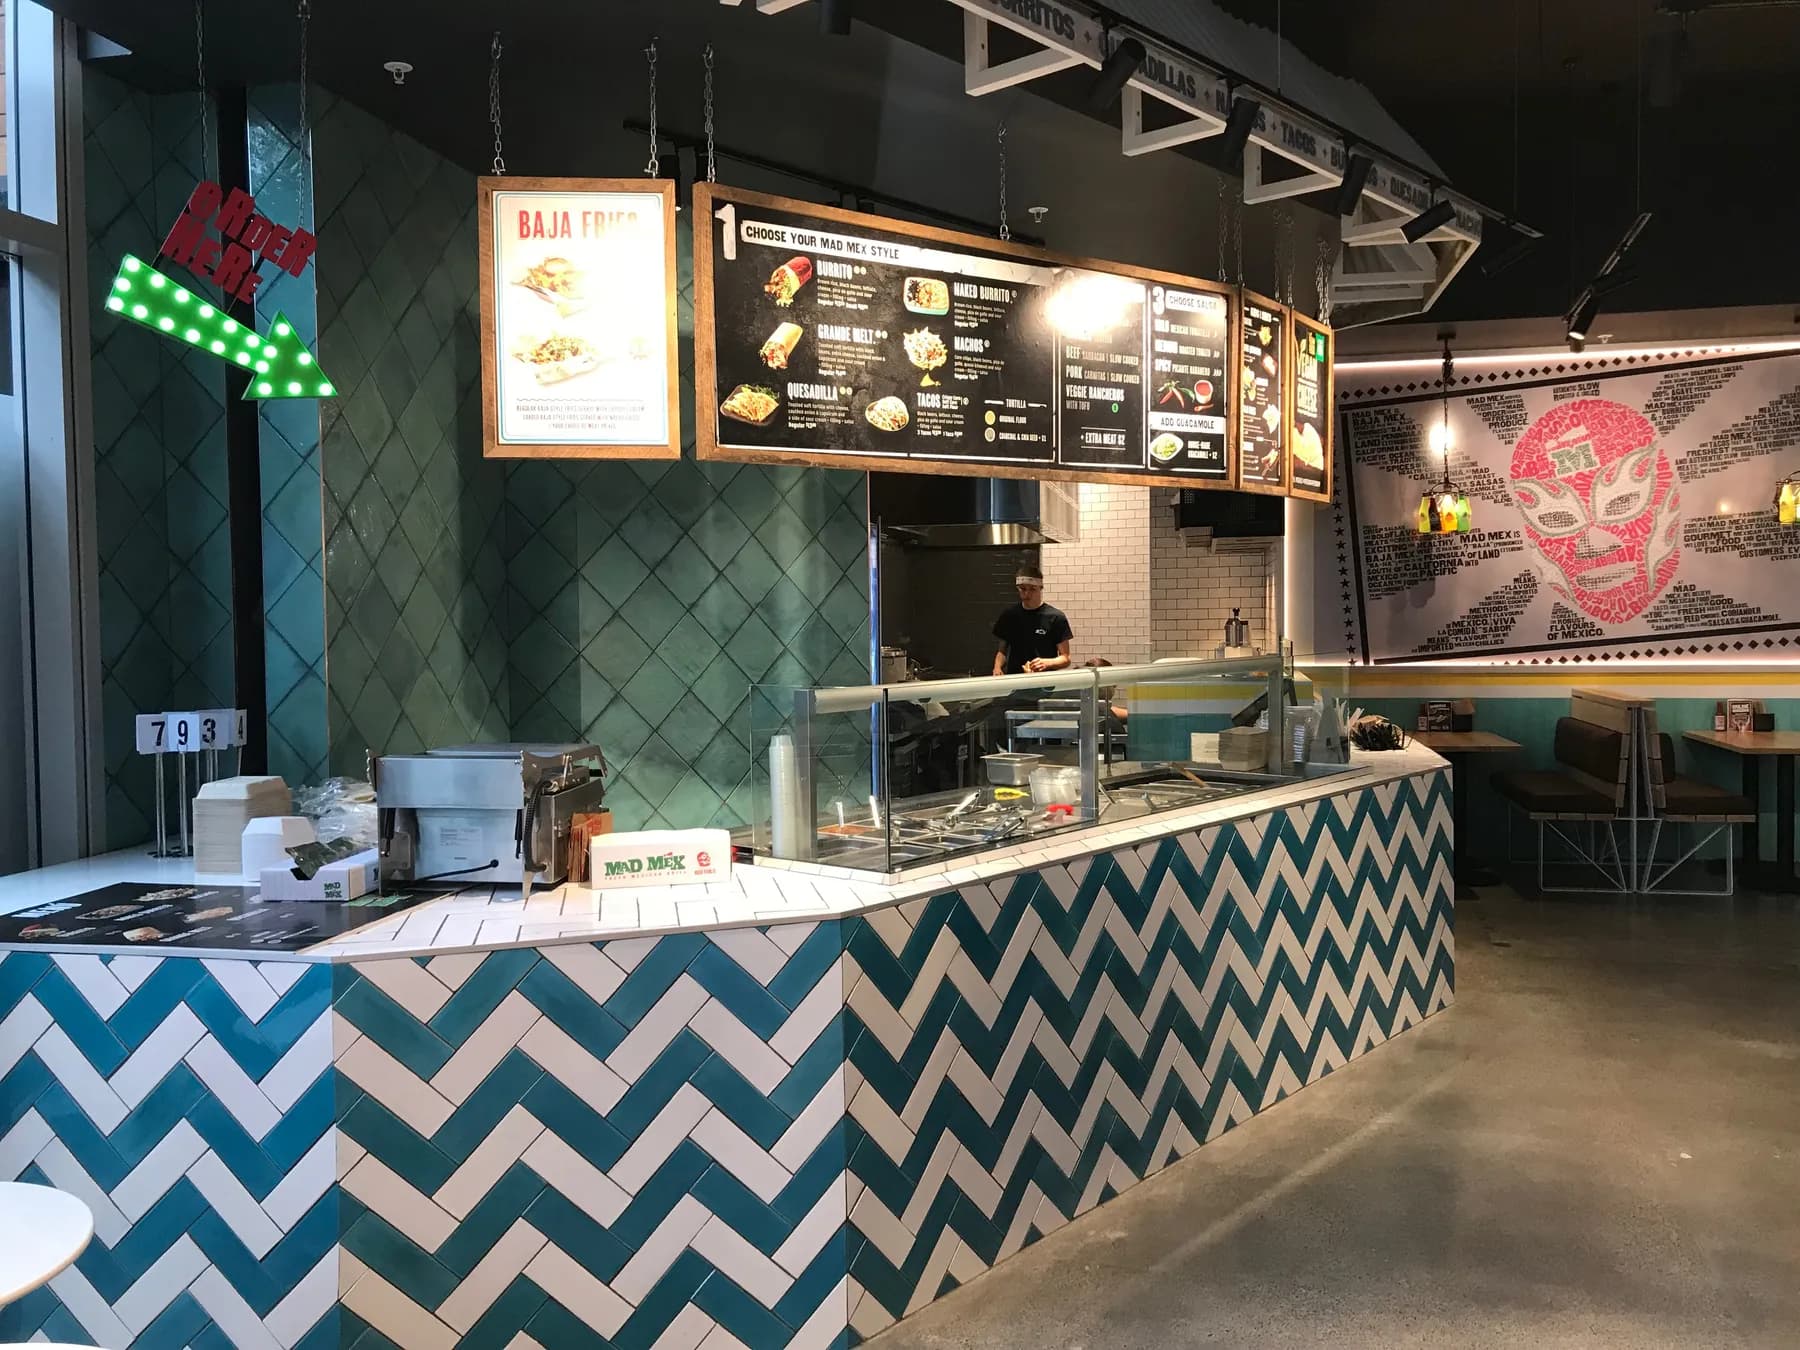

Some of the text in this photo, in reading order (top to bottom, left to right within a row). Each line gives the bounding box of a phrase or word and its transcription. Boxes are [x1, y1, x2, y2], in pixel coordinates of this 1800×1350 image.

[1281, 120, 1316, 156] TACOS
[188, 180, 318, 278] ORDER
[519, 209, 572, 239] BAJA
[714, 203, 900, 261] 1 CHOOSE YOUR MAD MEX STYLE
[161, 214, 263, 304] HERE
[817, 260, 852, 280] BURRITO
[954, 281, 978, 299] NAKED
[1169, 295, 1195, 307] CHOOSE
[817, 323, 851, 342] GRANDE
[954, 335, 984, 353] NACHOS
[1066, 344, 1081, 359] BEEF
[1066, 364, 1082, 379] PORK
[787, 381, 838, 402] QUESADILLA
[1577, 381, 1600, 391] SLOW
[1065, 384, 1125, 402] VEGGIE RANCHEROS
[917, 392, 941, 408] TACOS
[1466, 394, 1505, 405] MAD MEX
[1644, 401, 1667, 410] MAD
[1506, 402, 1525, 410] MADE
[1661, 404, 1695, 416] BURRITOS
[1352, 413, 1406, 425] BAJA MEX
[1482, 409, 1506, 417] ORDER
[1490, 412, 1529, 422] FRESHEST
[1161, 417, 1215, 430] ADD GUACAMOLE
[1752, 418, 1780, 426] FRESH
[1085, 431, 1102, 444] EXTRA
[1103, 432, 1117, 445] MEAT
[1730, 431, 1753, 441] MEX
[1354, 439, 1380, 449] LAND
[1709, 439, 1730, 447] TACOS
[1686, 445, 1730, 457] FRESHEST
[1355, 454, 1386, 463] PACIFIC
[1471, 467, 1490, 475] MAD
[1469, 477, 1505, 488] SALSAS
[1707, 517, 1747, 528] MAD MEX
[1734, 523, 1754, 531] BEST
[1364, 543, 1408, 555] EXCITING
[1459, 532, 1486, 544] MAD
[1487, 530, 1512, 541] MEX
[1513, 529, 1521, 538] IS
[1683, 530, 1734, 543] GOURMET
[1715, 536, 1741, 546] FOOD
[1755, 531, 1800, 542] CULTURE
[1423, 550, 1466, 561] PENINSULA
[1477, 548, 1500, 560] LAND
[1704, 543, 1747, 555] FIGHTING
[1739, 546, 1785, 559] CUSTOMERS
[1365, 552, 1393, 563] BAJA
[1366, 566, 1392, 575] SOUTH
[1403, 559, 1464, 572] CALIFORNIA
[1367, 566, 1458, 582] MEXICO PACIFIC
[1367, 579, 1395, 588] OCEAN
[1512, 576, 1537, 585] MEANS
[1673, 584, 1696, 593] MAD
[1709, 597, 1734, 606] GOOD
[1469, 605, 1509, 614] METHODS
[1677, 607, 1706, 616] FRESH
[1683, 606, 1762, 623] RED CORIANDER
[1550, 621, 1596, 632] FLAVOURS
[1557, 616, 1586, 625] ROBUST
[1707, 617, 1732, 627] SALSAS
[1547, 632, 1560, 641] OF
[1417, 638, 1505, 653] IMPORTED CHILLIES
[151, 715, 244, 746] 7 9 3 4
[604, 858, 643, 876] MAD
